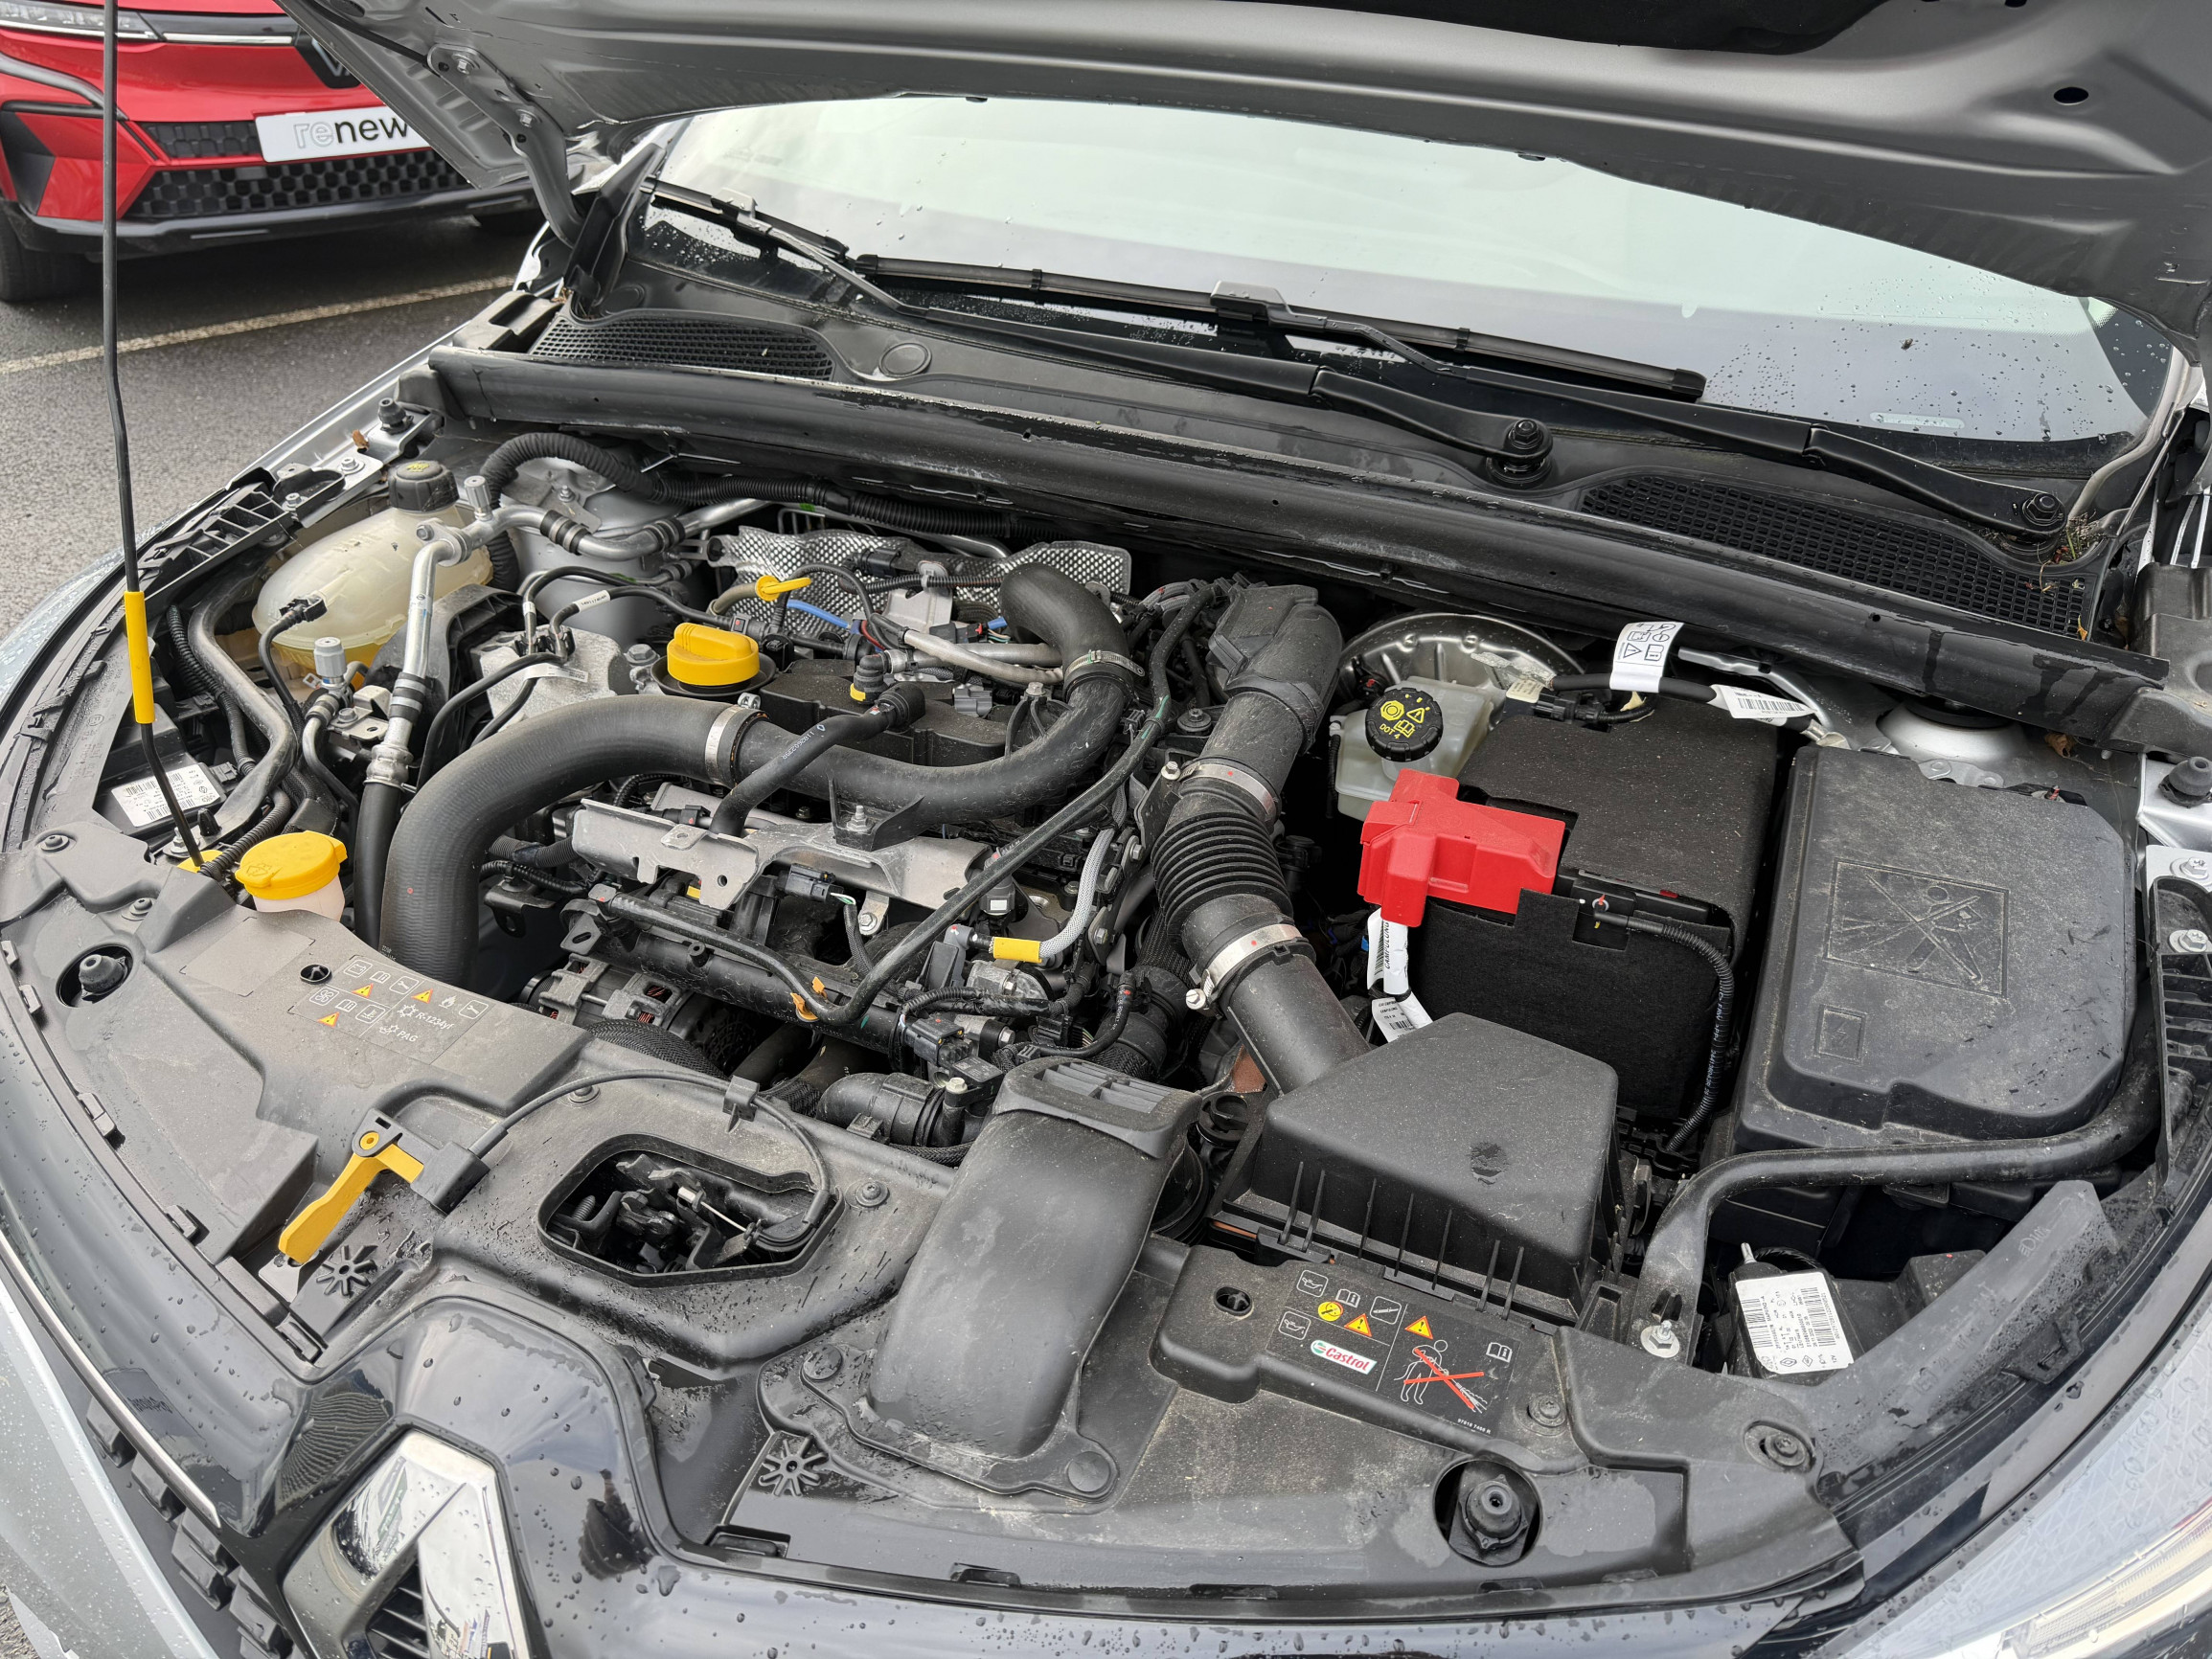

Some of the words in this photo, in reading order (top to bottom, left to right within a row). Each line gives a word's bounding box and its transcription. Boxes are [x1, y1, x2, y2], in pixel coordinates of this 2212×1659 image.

[293, 117, 408, 149] renew
[1380, 723, 1395, 736] DOT
[415, 1011, 455, 1031] R-1234yf
[397, 1030, 419, 1042] PAG
[1325, 1347, 1370, 1371] Castrol
